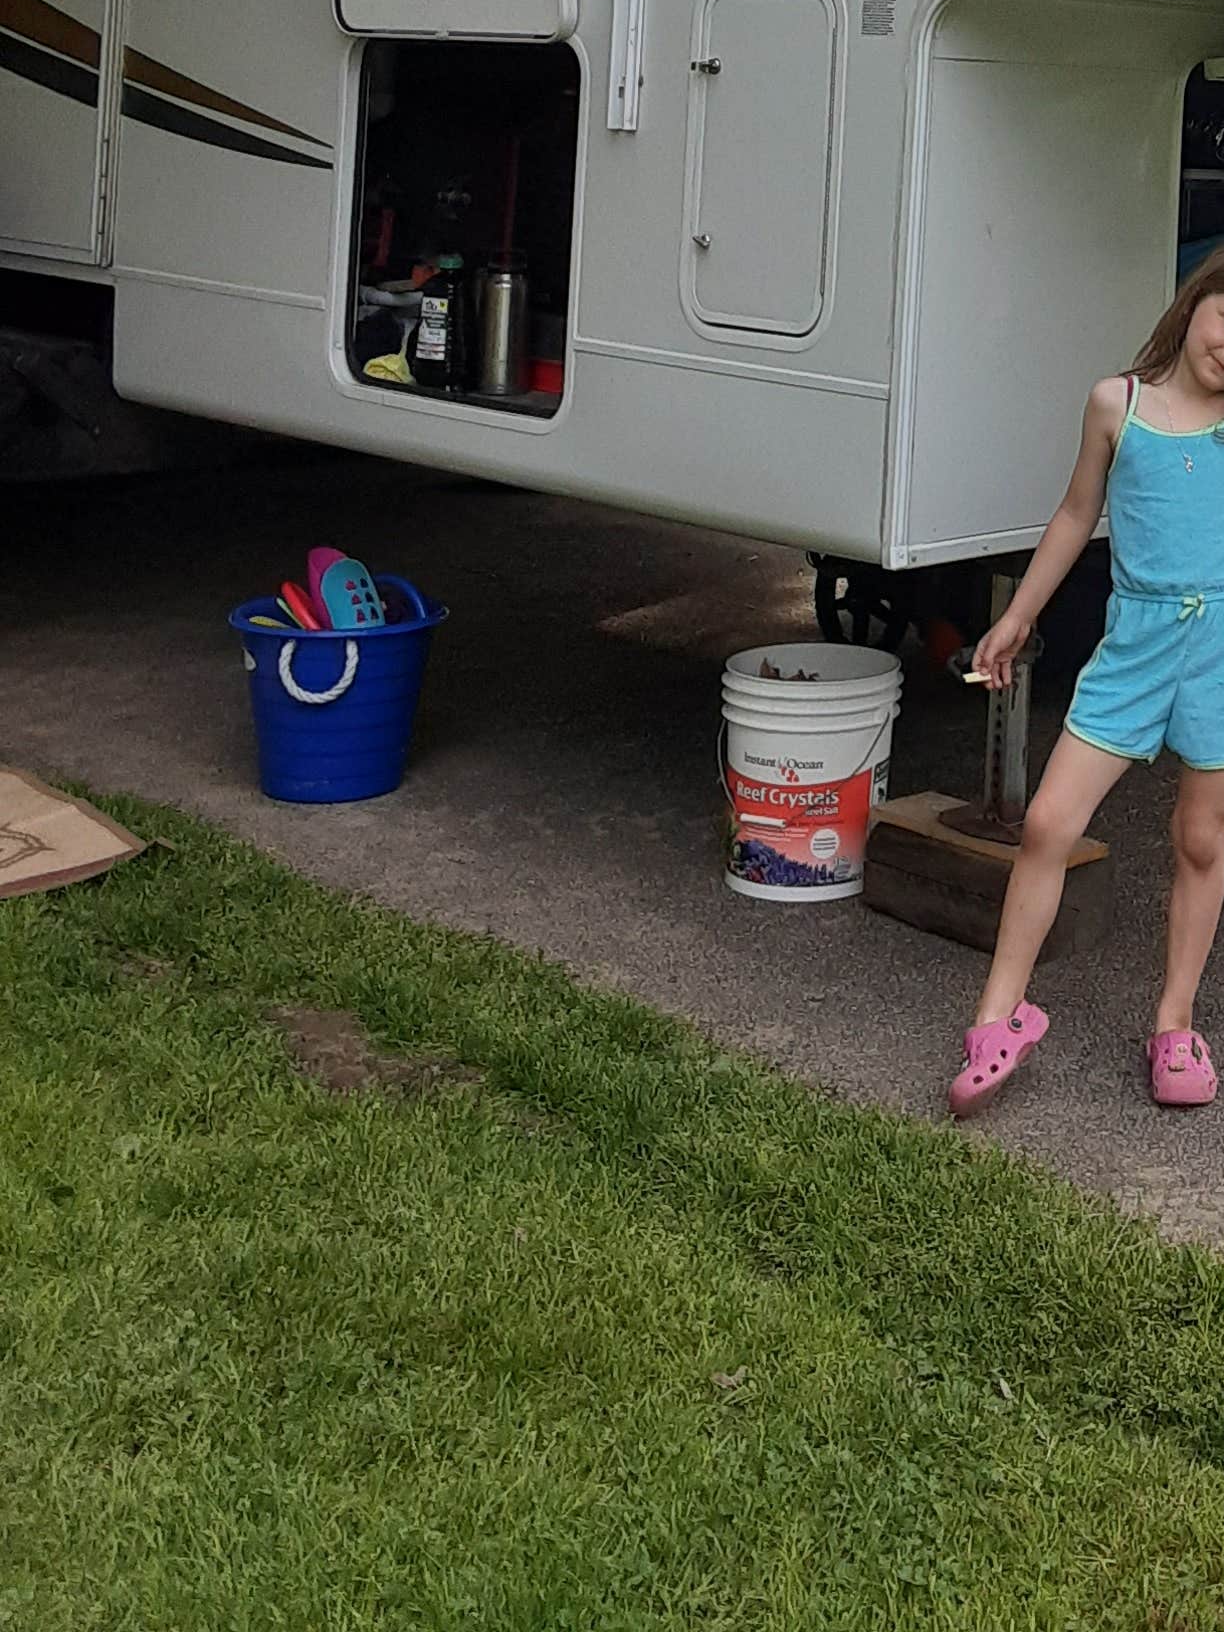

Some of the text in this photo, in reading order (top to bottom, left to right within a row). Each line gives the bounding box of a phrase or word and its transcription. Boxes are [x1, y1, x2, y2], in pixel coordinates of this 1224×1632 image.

[744, 752, 824, 769] Instant Ocean
[736, 780, 840, 808] Reef Crystals
